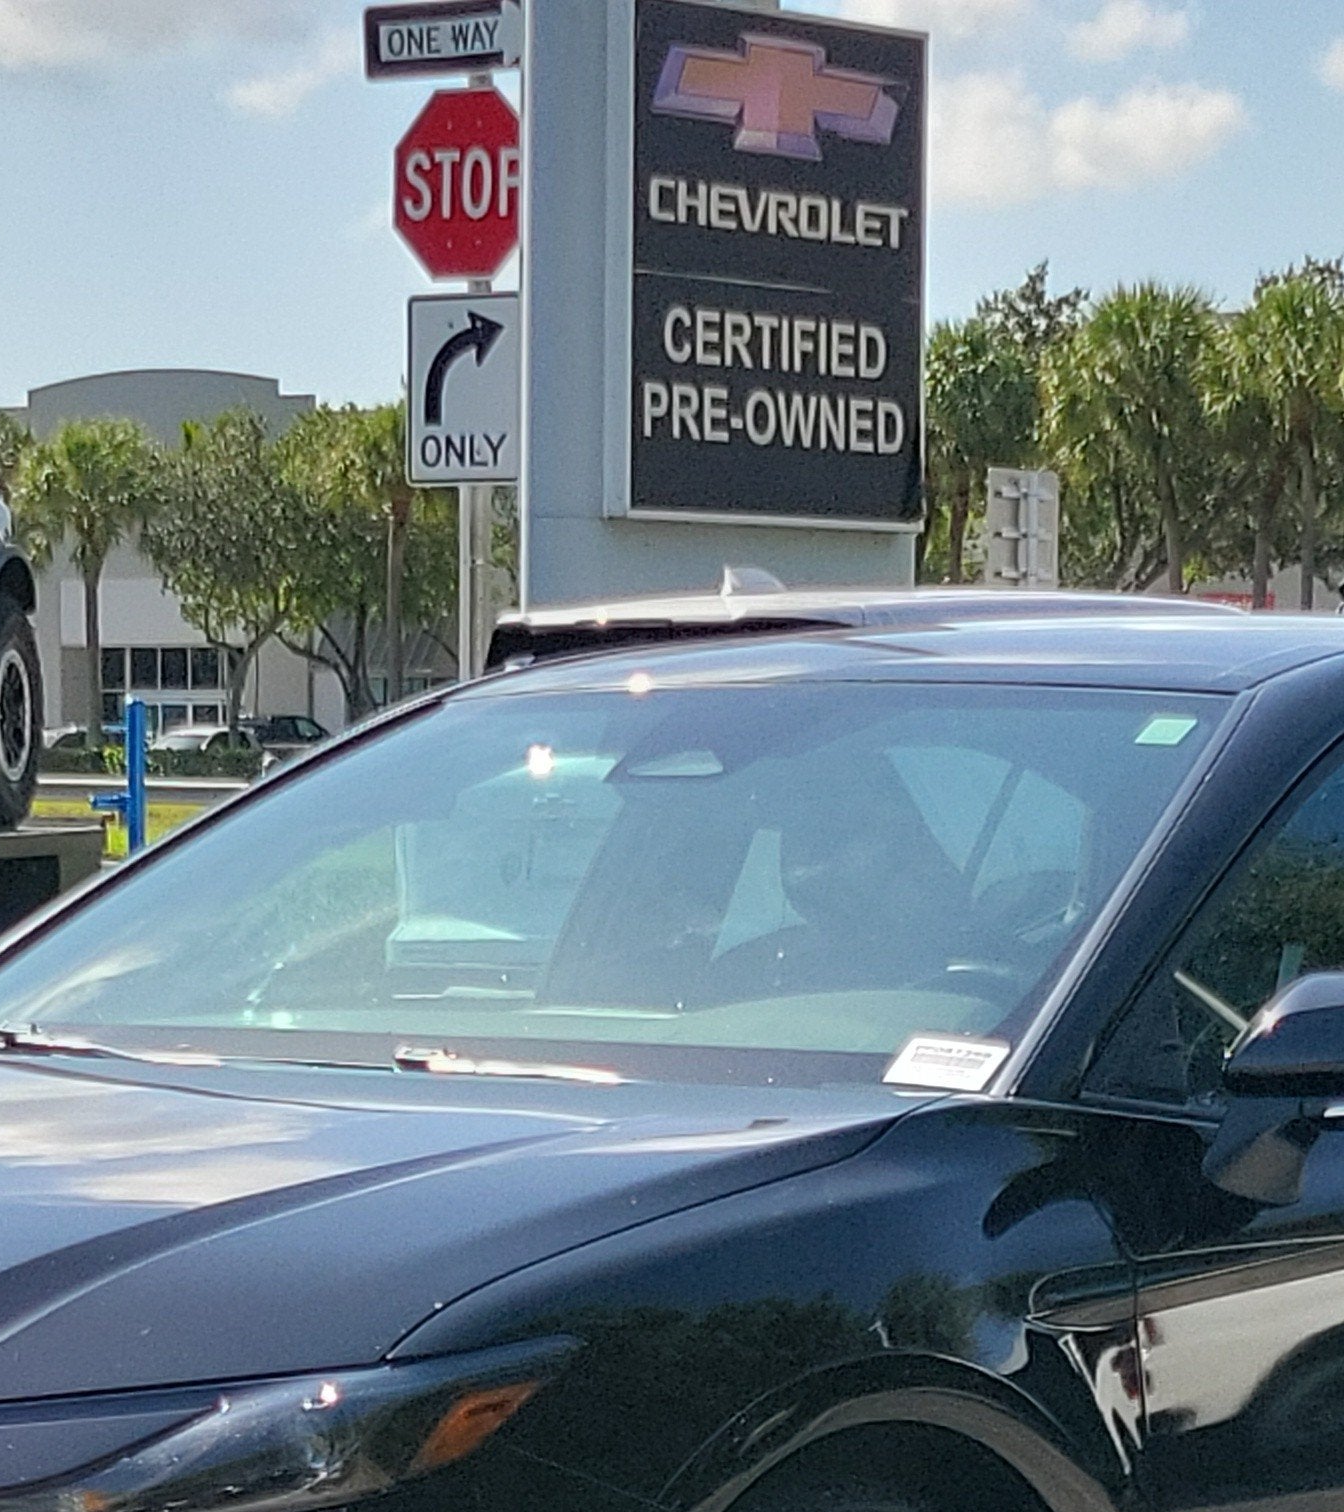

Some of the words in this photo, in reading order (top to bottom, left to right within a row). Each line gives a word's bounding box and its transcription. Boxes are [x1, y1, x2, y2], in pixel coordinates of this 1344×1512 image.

[387, 26, 442, 57] ONE
[451, 19, 499, 51] WAY
[649, 177, 908, 250] CHEVROLET
[663, 305, 887, 380] CERTIFIED
[421, 433, 507, 468] ONLY
[643, 381, 904, 455] PRE-OWNED
